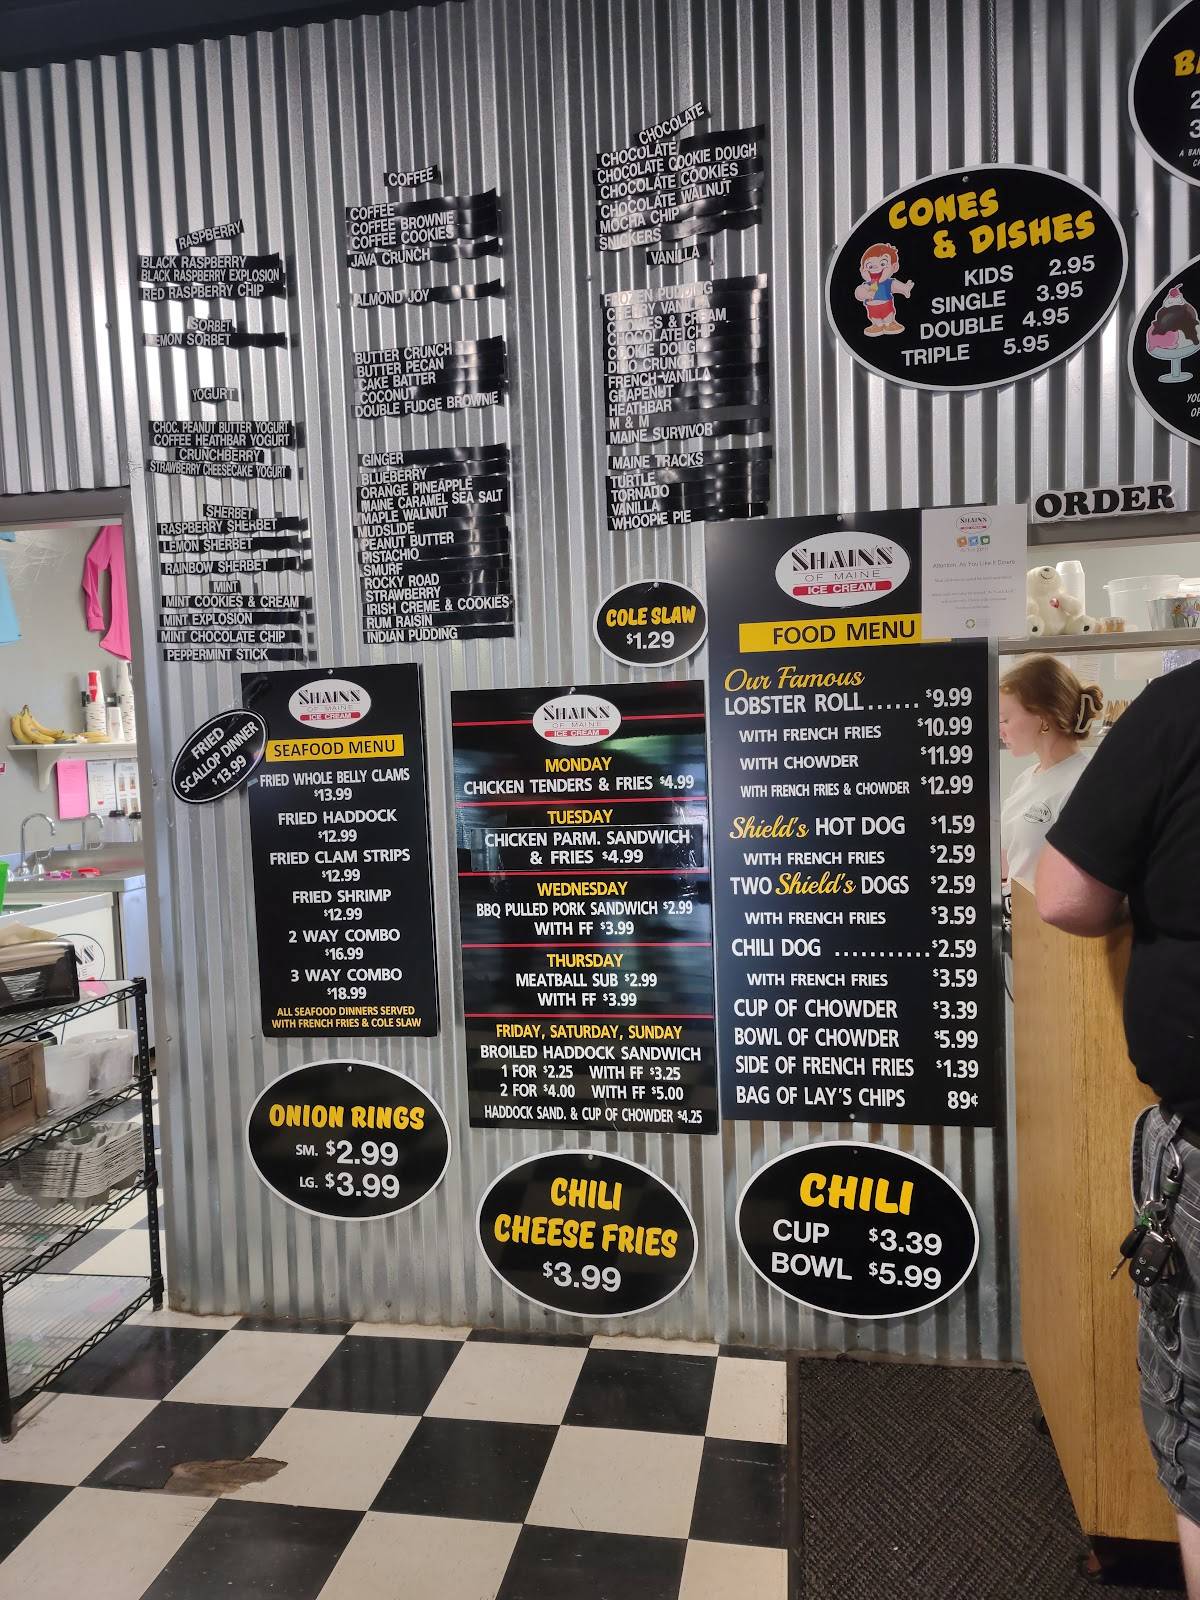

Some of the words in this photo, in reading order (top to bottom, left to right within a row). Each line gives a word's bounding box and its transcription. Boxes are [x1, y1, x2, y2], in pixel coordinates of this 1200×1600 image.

[639, 102, 705, 145] CHOCOLATE
[598, 158, 664, 184] CHOCOLATE
[668, 149, 711, 171] COOKIE
[715, 142, 757, 161] DOUGH
[388, 168, 433, 186] COFFEE
[888, 188, 999, 230] CONES
[601, 214, 646, 234] MOCHA
[651, 208, 680, 224] CHIP
[932, 230, 956, 259] &
[969, 210, 1096, 255] DISHES
[351, 254, 377, 267] JAVA
[382, 248, 431, 265] CRUNCH
[141, 270, 170, 281] BLACK
[174, 270, 226, 281] RASPBERRY
[229, 269, 279, 281] EXPLOSION
[964, 265, 1014, 286] KIDS
[1049, 255, 1095, 276] 2.95
[931, 290, 1006, 314] SINGLE
[1036, 281, 1084, 302] 3.95
[920, 315, 1004, 340] DOUBLE
[1022, 307, 1070, 328] 4.95
[901, 344, 970, 366] TRIPLE
[1003, 334, 1050, 355] 5.95
[357, 363, 400, 378] BUTTER
[406, 358, 444, 372] PECAN
[179, 449, 260, 462] CRUNCHBERRY
[362, 453, 404, 466] GINGER
[613, 455, 650, 469] MAINE
[655, 452, 703, 467] TRACKS
[611, 472, 656, 488] TURTLE
[611, 485, 669, 502] TORNADO
[1035, 484, 1175, 518] ORDER
[673, 510, 692, 524] PIE
[804, 572, 823, 581] OF
[834, 570, 881, 580] MAINE
[808, 584, 828, 594] ICE
[832, 582, 876, 593] CREAM
[367, 602, 396, 615] IRISH
[401, 601, 440, 613] CREME
[445, 598, 453, 611] &
[458, 596, 510, 610] COOKIES
[367, 617, 391, 629] RUM
[396, 614, 433, 628] RAISIN
[606, 608, 648, 627] COLE
[651, 605, 697, 625] SLAW
[161, 631, 186, 642] MINT
[190, 631, 255, 643] CHOCOLATE
[259, 630, 285, 642] CHIP
[367, 630, 404, 643] INDIAN
[409, 628, 458, 641] PUDDING
[626, 630, 675, 650] $1.29
[773, 625, 836, 645] FOOD
[847, 620, 916, 640] MENU
[167, 649, 231, 661] PEPPERMINT
[236, 649, 268, 660] STICK
[724, 668, 771, 692] Our
[777, 666, 865, 688] Famous
[191, 727, 224, 760] FRIED
[274, 742, 343, 757] SEAFOOD
[349, 740, 395, 754] MENU
[180, 751, 220, 793] SCALLOP
[222, 721, 258, 758] DINNER
[545, 757, 612, 772] MONDAY
[740, 758, 778, 771] WITH
[784, 755, 858, 769] CHOWDER
[921, 745, 973, 765] $11.99
[211, 755, 247, 785] $13.99
[260, 774, 289, 787] FRIED
[293, 772, 332, 785] WHOLE
[337, 770, 367, 784] BELLY
[372, 768, 410, 783] CLAMS
[314, 788, 353, 801] $13.99
[464, 780, 524, 795] CHICKEN
[530, 778, 592, 793] TENDERS
[599, 778, 609, 791] &
[616, 776, 653, 791] FRIES
[660, 775, 694, 790] $4.99
[741, 785, 767, 797] WITH
[771, 784, 810, 796] FRENCH
[814, 783, 840, 796] FRIES
[843, 783, 851, 795] &
[856, 781, 910, 795] CHOWDER
[921, 775, 973, 795] $12.99
[547, 809, 613, 824] TUESDAY
[729, 815, 809, 839] Shield's
[816, 818, 855, 835] HOT
[862, 817, 905, 835] DOG
[931, 815, 975, 834] $1.59
[484, 831, 547, 848] CHICKEN
[554, 831, 600, 846] PARM.
[607, 829, 690, 845] SANDWICH
[530, 851, 542, 864] &
[551, 850, 594, 864] FRIES
[602, 849, 644, 863] $4.99
[293, 891, 331, 904] FRIED
[337, 889, 391, 903] SHRIMP
[537, 882, 628, 897] WEDNESDAY
[547, 954, 624, 968] THURSDAY
[291, 970, 299, 982] 3
[305, 969, 341, 981] WAY
[347, 968, 402, 981] COMBO
[327, 987, 366, 1000] $18.99
[277, 1008, 292, 1016] ALL
[294, 1007, 336, 1016] SEAFOOD
[339, 1006, 378, 1015] DINNERS
[381, 1006, 415, 1015] SERVED
[734, 999, 768, 1016] CUP
[774, 999, 798, 1017] OF
[805, 1000, 898, 1018] CHOWDER
[933, 1001, 978, 1019] $3.39
[272, 1019, 296, 1028] WITH
[298, 1019, 333, 1028] FRENCH
[335, 1018, 359, 1027] FRIES
[362, 1018, 369, 1027] &
[372, 1018, 395, 1027] COLE
[397, 1018, 421, 1027] SLAW
[496, 1024, 545, 1040] FRIDAY,
[550, 1025, 623, 1040] SATURDAY,
[628, 1025, 682, 1040] SUNDAY
[480, 1045, 538, 1059] BROILED
[543, 1046, 615, 1060] HADDOCK
[621, 1047, 701, 1061] SANDWICH
[736, 1086, 770, 1104] BAG
[776, 1086, 798, 1105] OF
[804, 1088, 852, 1106] LAY'S
[859, 1088, 906, 1107] CHIPS
[947, 1091, 979, 1109] 89¢
[269, 1104, 347, 1128] ONION
[351, 1106, 425, 1131] RINGS
[485, 1105, 533, 1119] HADDOCK
[537, 1106, 566, 1120] SAND.
[571, 1107, 578, 1120] &
[581, 1108, 601, 1121] CUP
[605, 1108, 618, 1121] OF
[622, 1108, 673, 1122] CHOWDER
[678, 1110, 702, 1123] $4.25
[295, 1143, 318, 1156] SM.
[326, 1141, 398, 1166] $2.99
[300, 1177, 318, 1189] LG.
[325, 1173, 400, 1198] $3.99
[550, 1177, 622, 1211] CHILI
[800, 1172, 914, 1215] CHILI
[494, 1214, 595, 1250] CHEESE
[601, 1223, 678, 1259] FRIES
[773, 1219, 829, 1244] CUP
[869, 1228, 942, 1256] $3.39
[543, 1261, 622, 1293] $3.99
[771, 1252, 852, 1280] BOWL
[869, 1261, 942, 1290] $5.99
